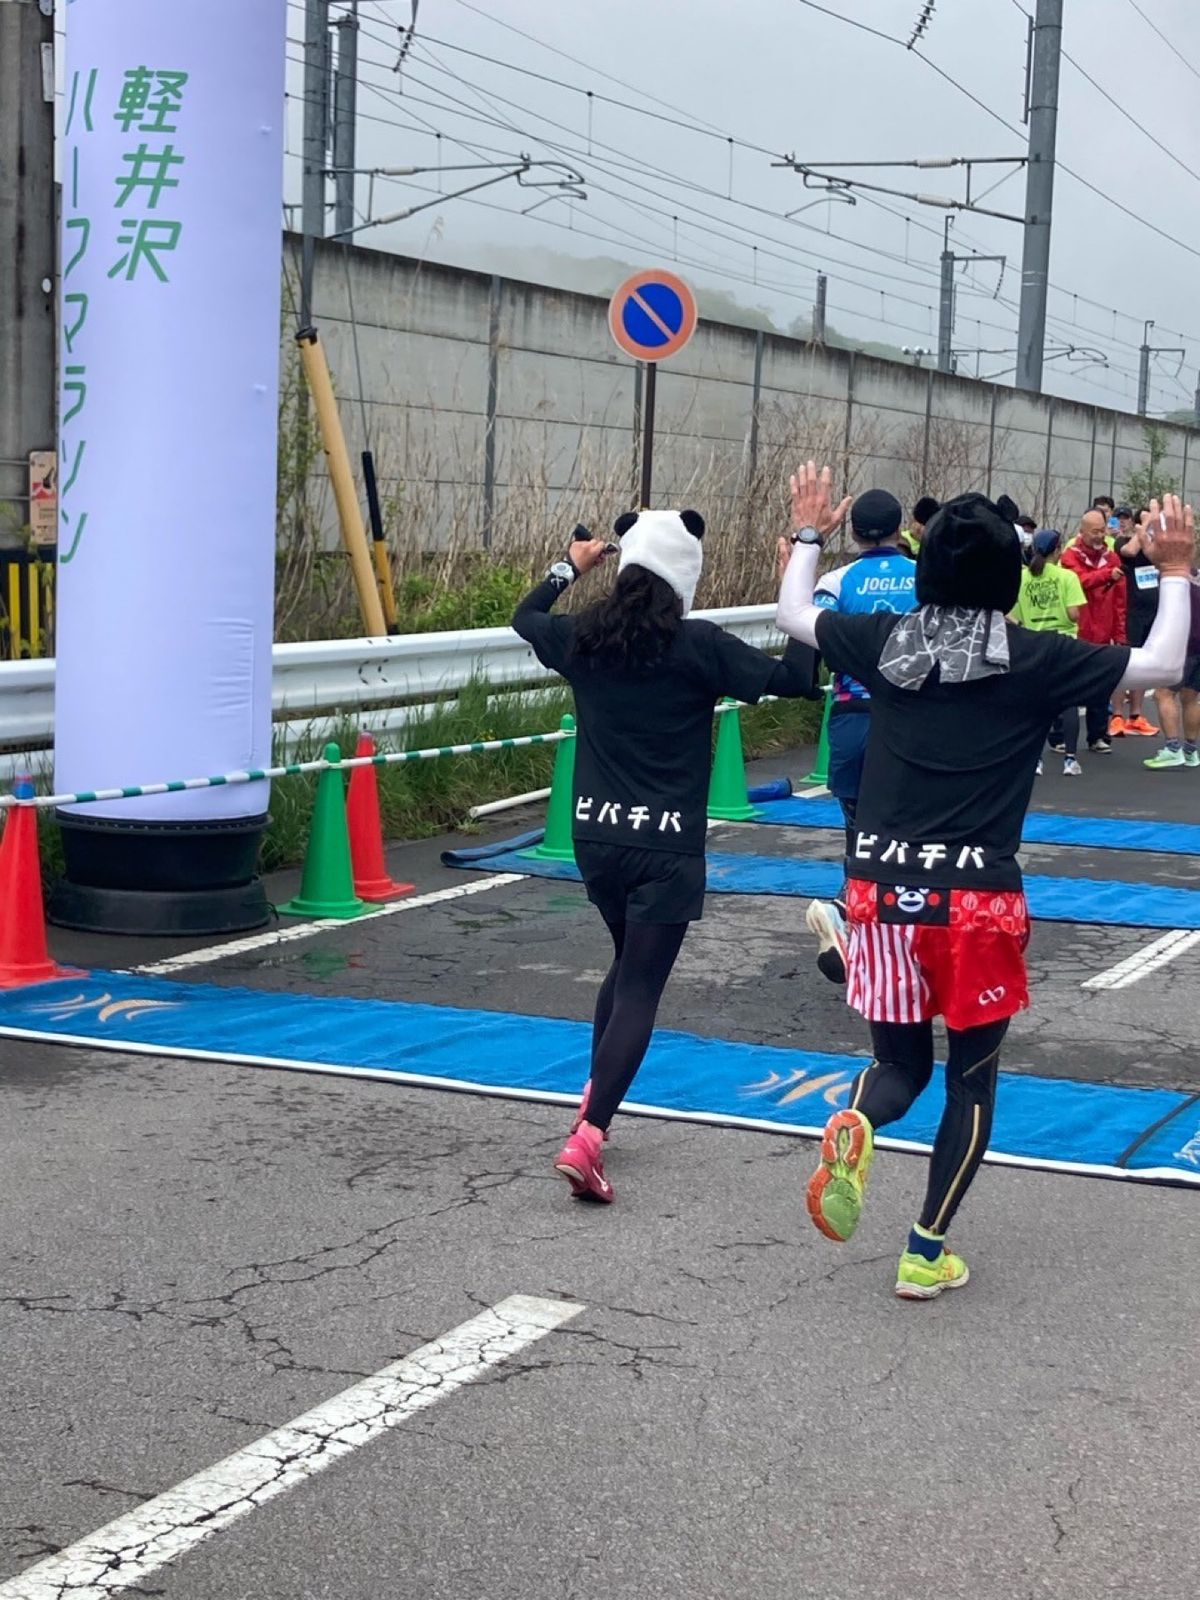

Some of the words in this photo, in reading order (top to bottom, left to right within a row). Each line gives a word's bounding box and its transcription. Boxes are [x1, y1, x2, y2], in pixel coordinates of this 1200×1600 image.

[107, 65, 189, 282] 軽井沢
[856, 576, 916, 595] JOGLIS
[575, 796, 682, 832] ビバチバ
[855, 831, 985, 869] ビバチバ
